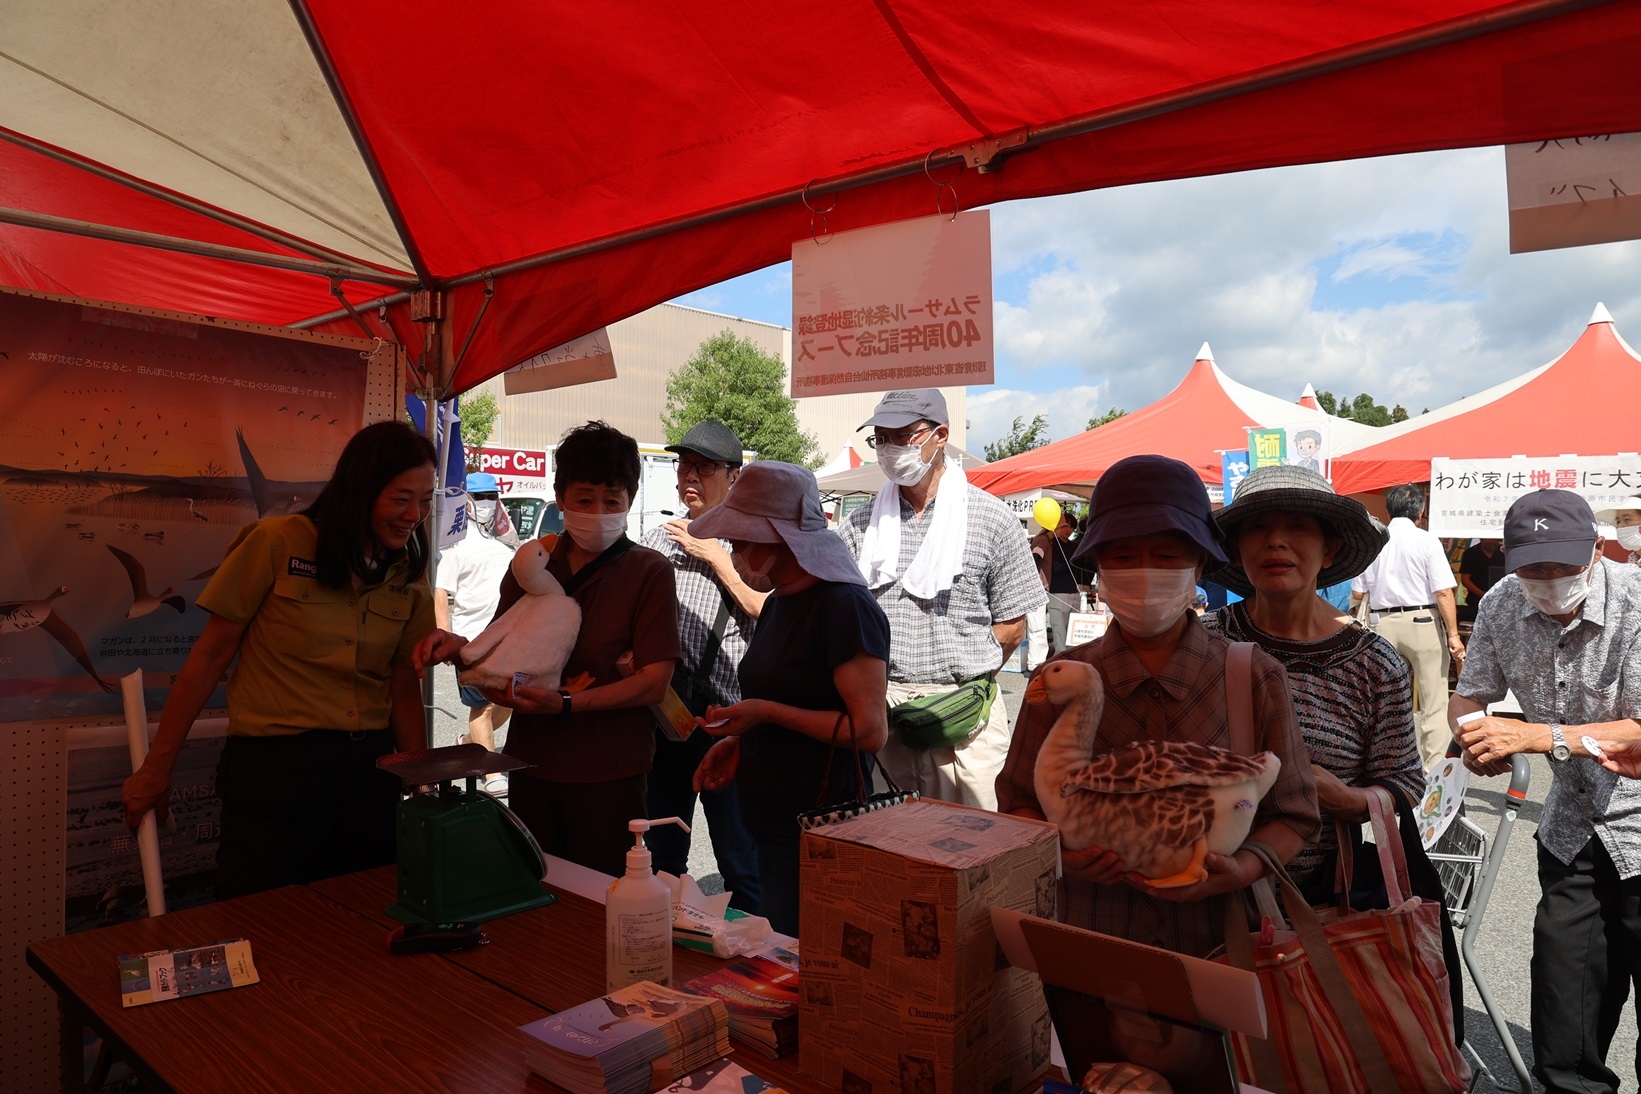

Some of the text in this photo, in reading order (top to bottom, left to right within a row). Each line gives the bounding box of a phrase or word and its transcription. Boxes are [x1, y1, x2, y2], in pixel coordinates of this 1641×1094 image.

[513, 451, 545, 471] Car
[1435, 468, 1641, 491] わが家は地震に大
[1534, 518, 1550, 532] K
[290, 558, 318, 574] Rang
